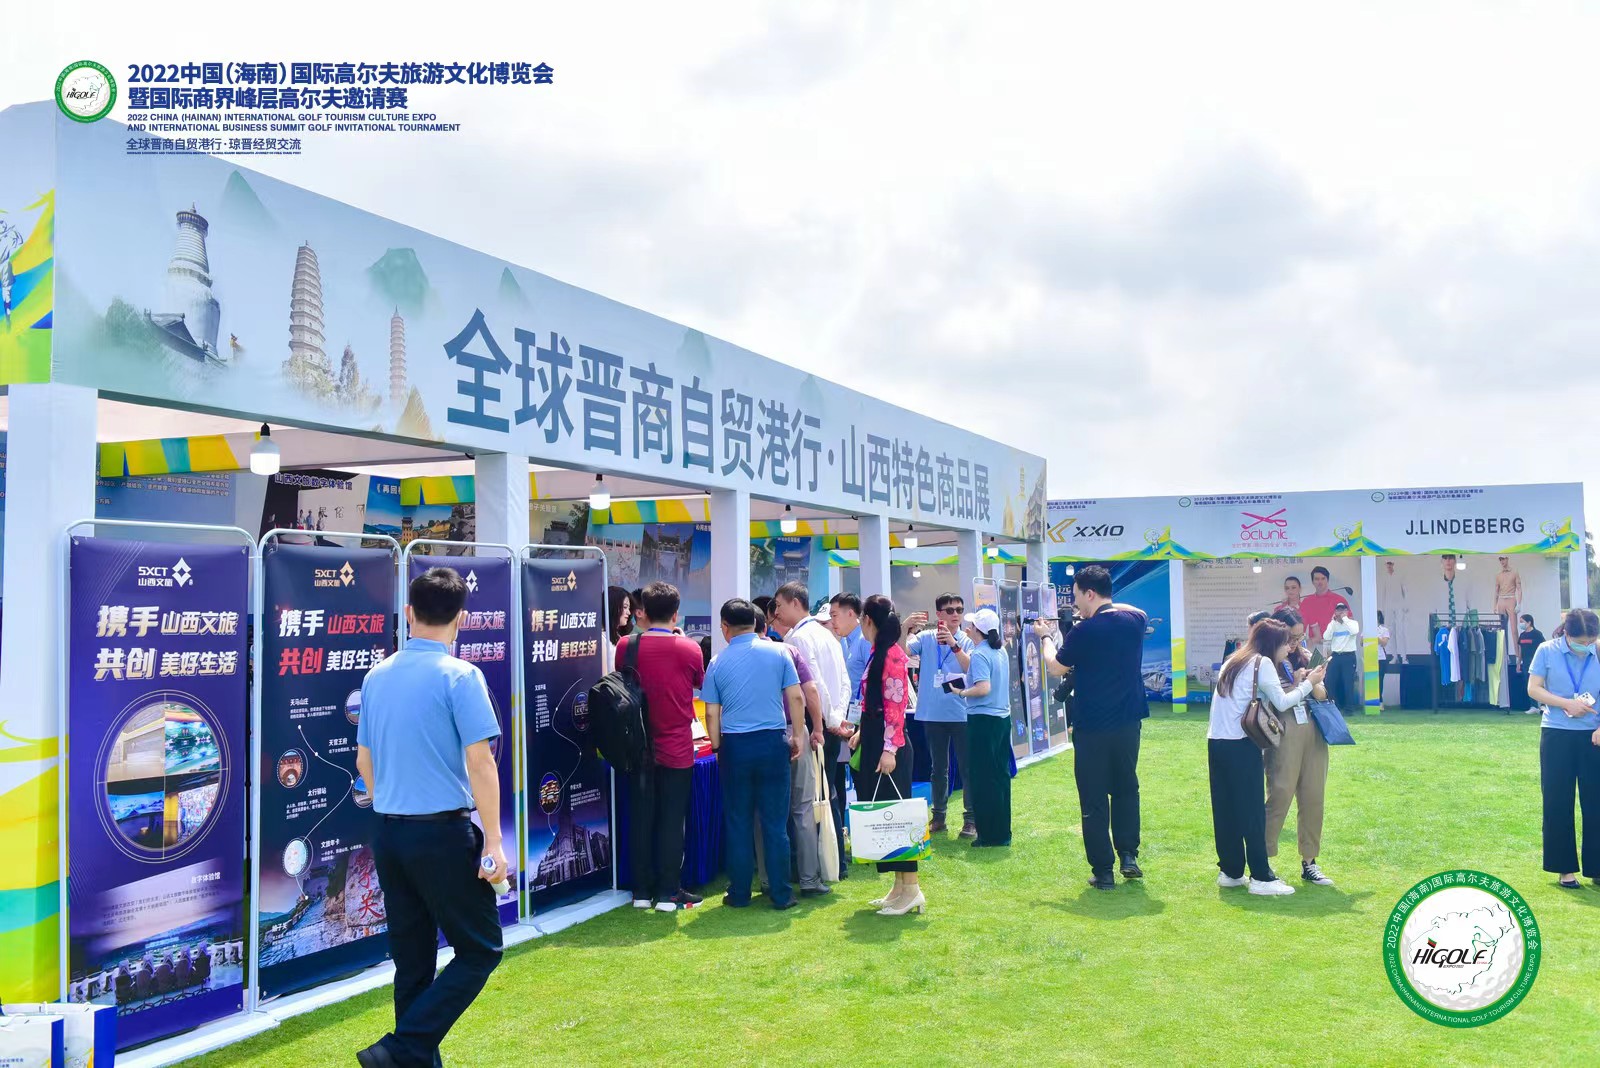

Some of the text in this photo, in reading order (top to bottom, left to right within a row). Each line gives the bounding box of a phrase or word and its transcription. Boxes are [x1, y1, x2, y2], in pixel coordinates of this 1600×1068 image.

[443, 307, 991, 523] 全球晋商自贸港行·山西特色商品展
[1073, 523, 1124, 537] XXIO
[1405, 517, 1525, 535] J.LINDEBERG
[138, 566, 168, 577] SXCT
[138, 578, 173, 587] 山西文旅
[314, 569, 337, 578] SXCT
[96, 605, 239, 637] 携手 山西文旅
[278, 609, 385, 637] 携手 山西文旅
[531, 609, 597, 632] 携手 山西文旅
[278, 647, 386, 676] 共创 美好生活
[459, 641, 506, 663] 美好生活
[531, 639, 597, 663] 共创 美好生活
[94, 647, 238, 681] 共创 美好生活
